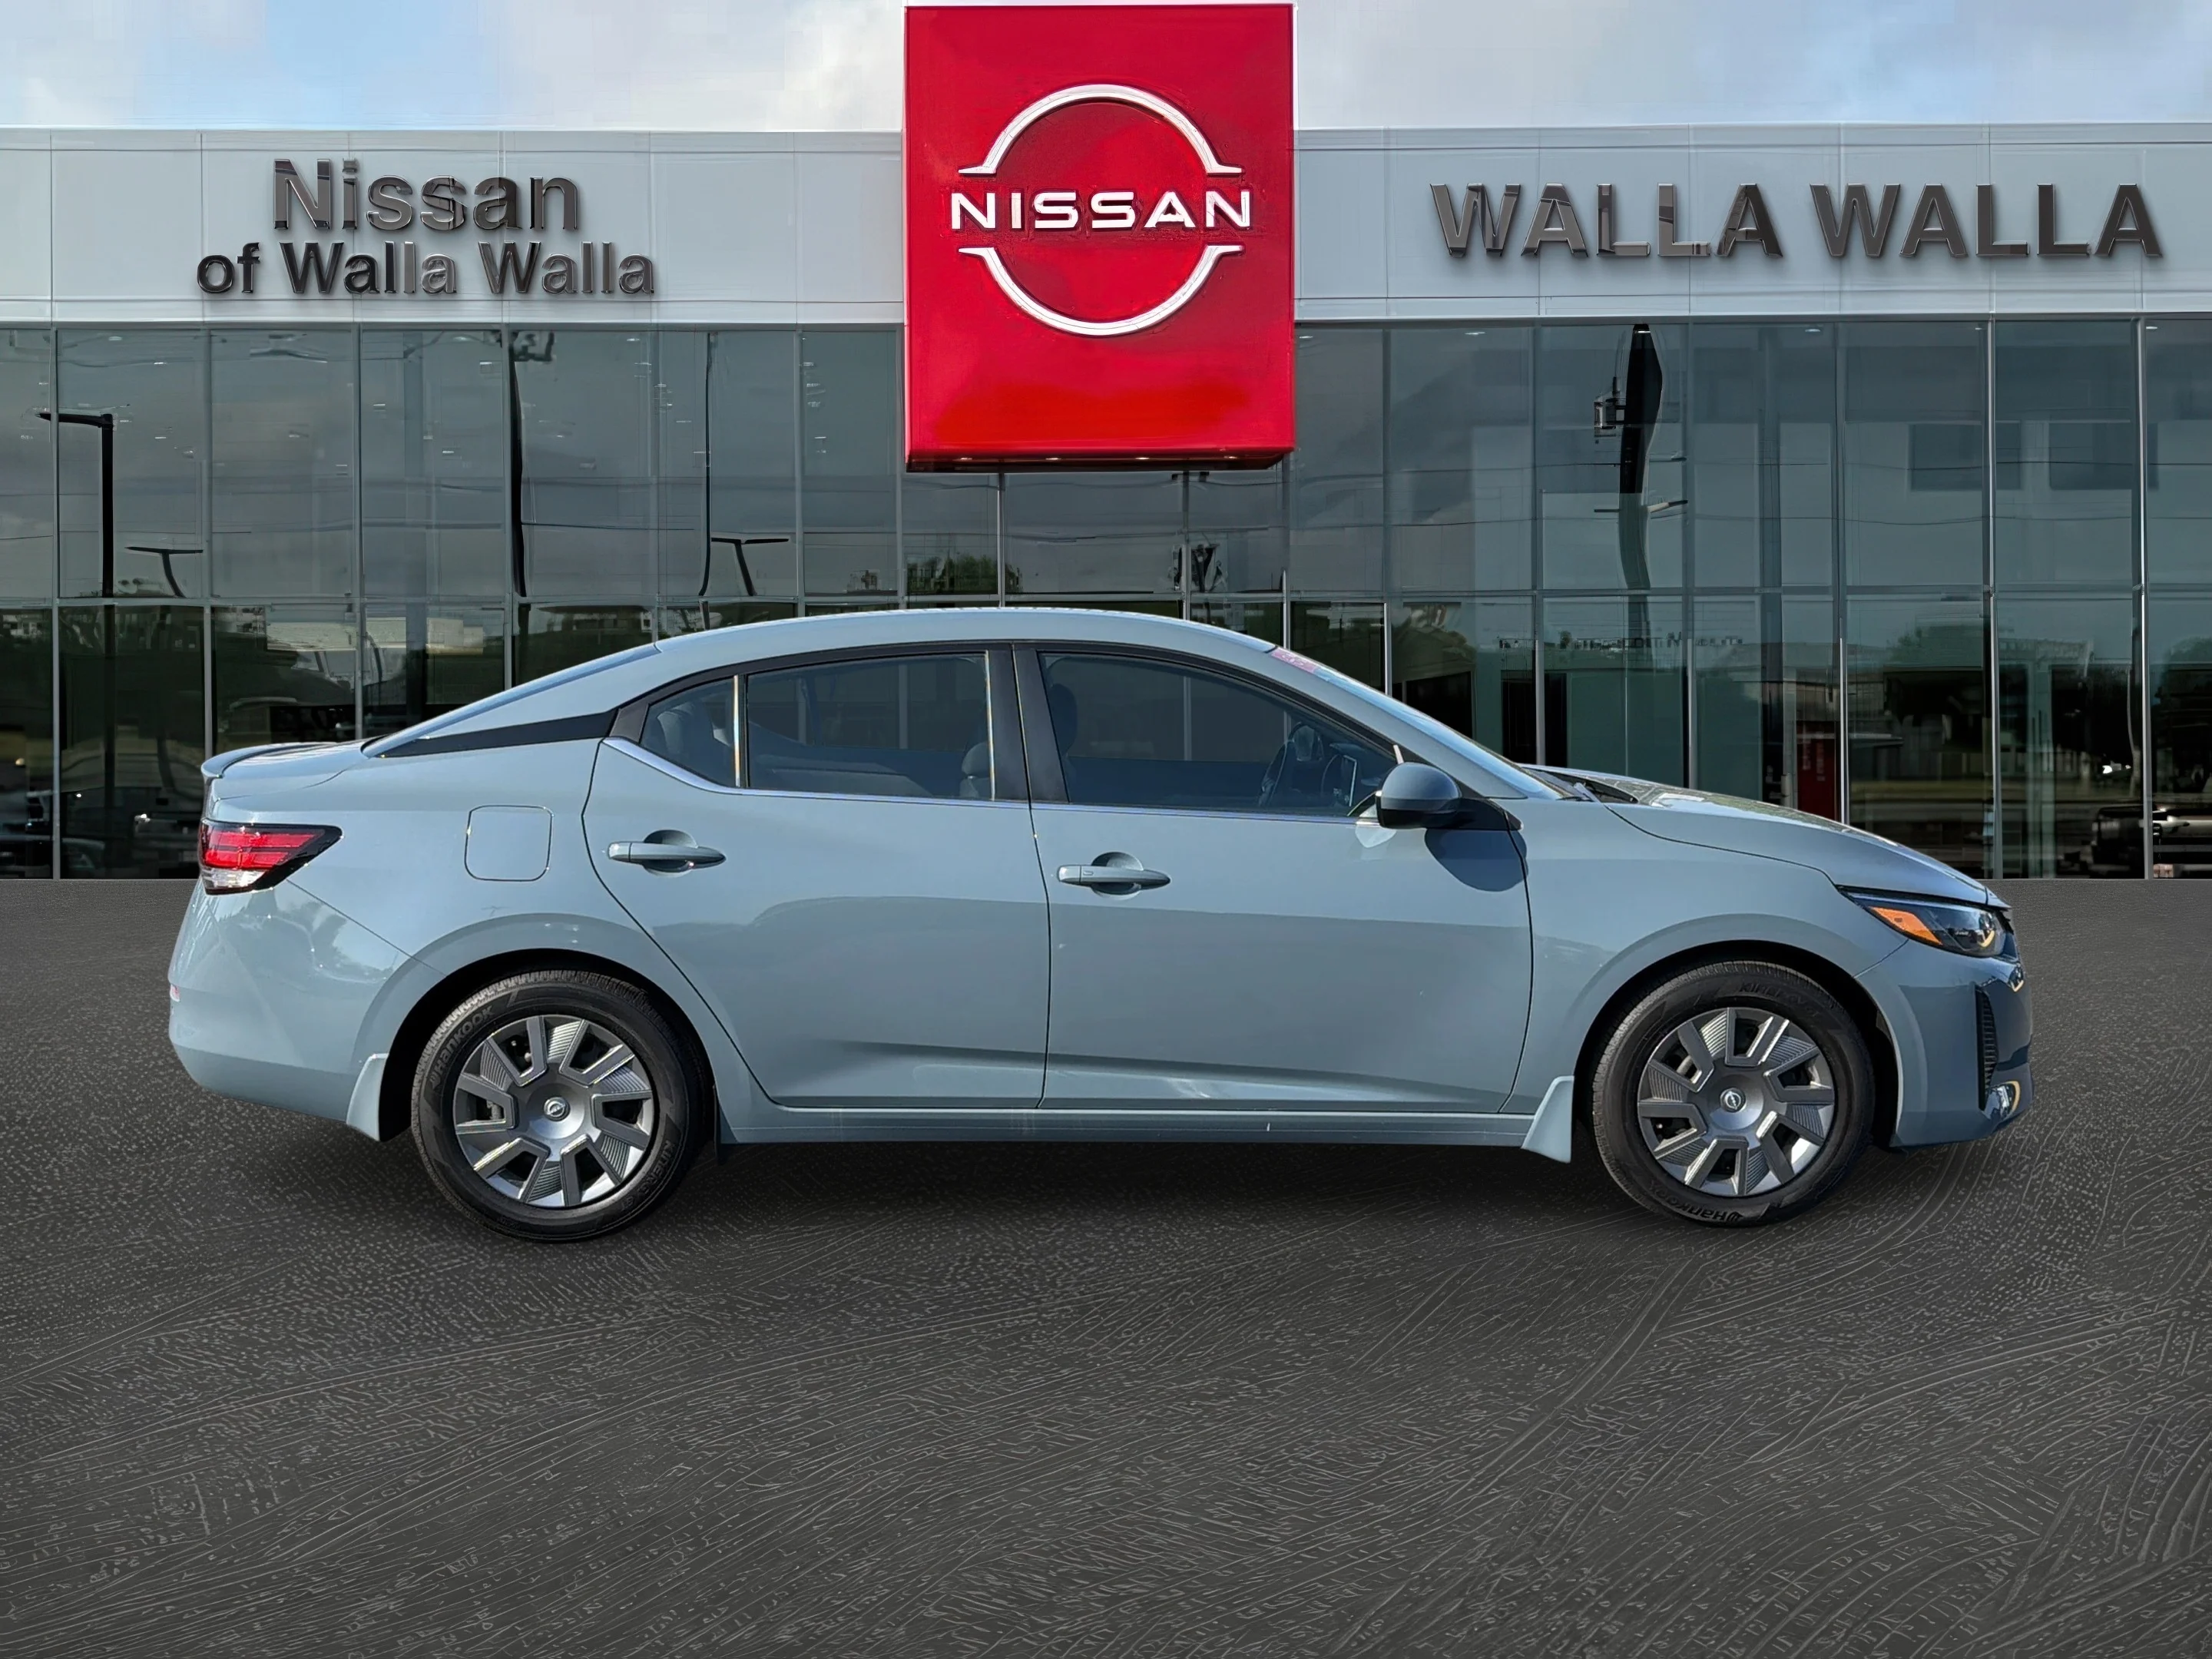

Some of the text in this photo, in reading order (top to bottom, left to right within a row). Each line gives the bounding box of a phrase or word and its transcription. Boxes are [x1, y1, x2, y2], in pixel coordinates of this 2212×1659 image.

[273, 158, 579, 230] Nissan
[951, 190, 1251, 230] NISSAN
[1429, 182, 2163, 258] WALLA WALLA
[197, 240, 654, 295] of Walla Walla
